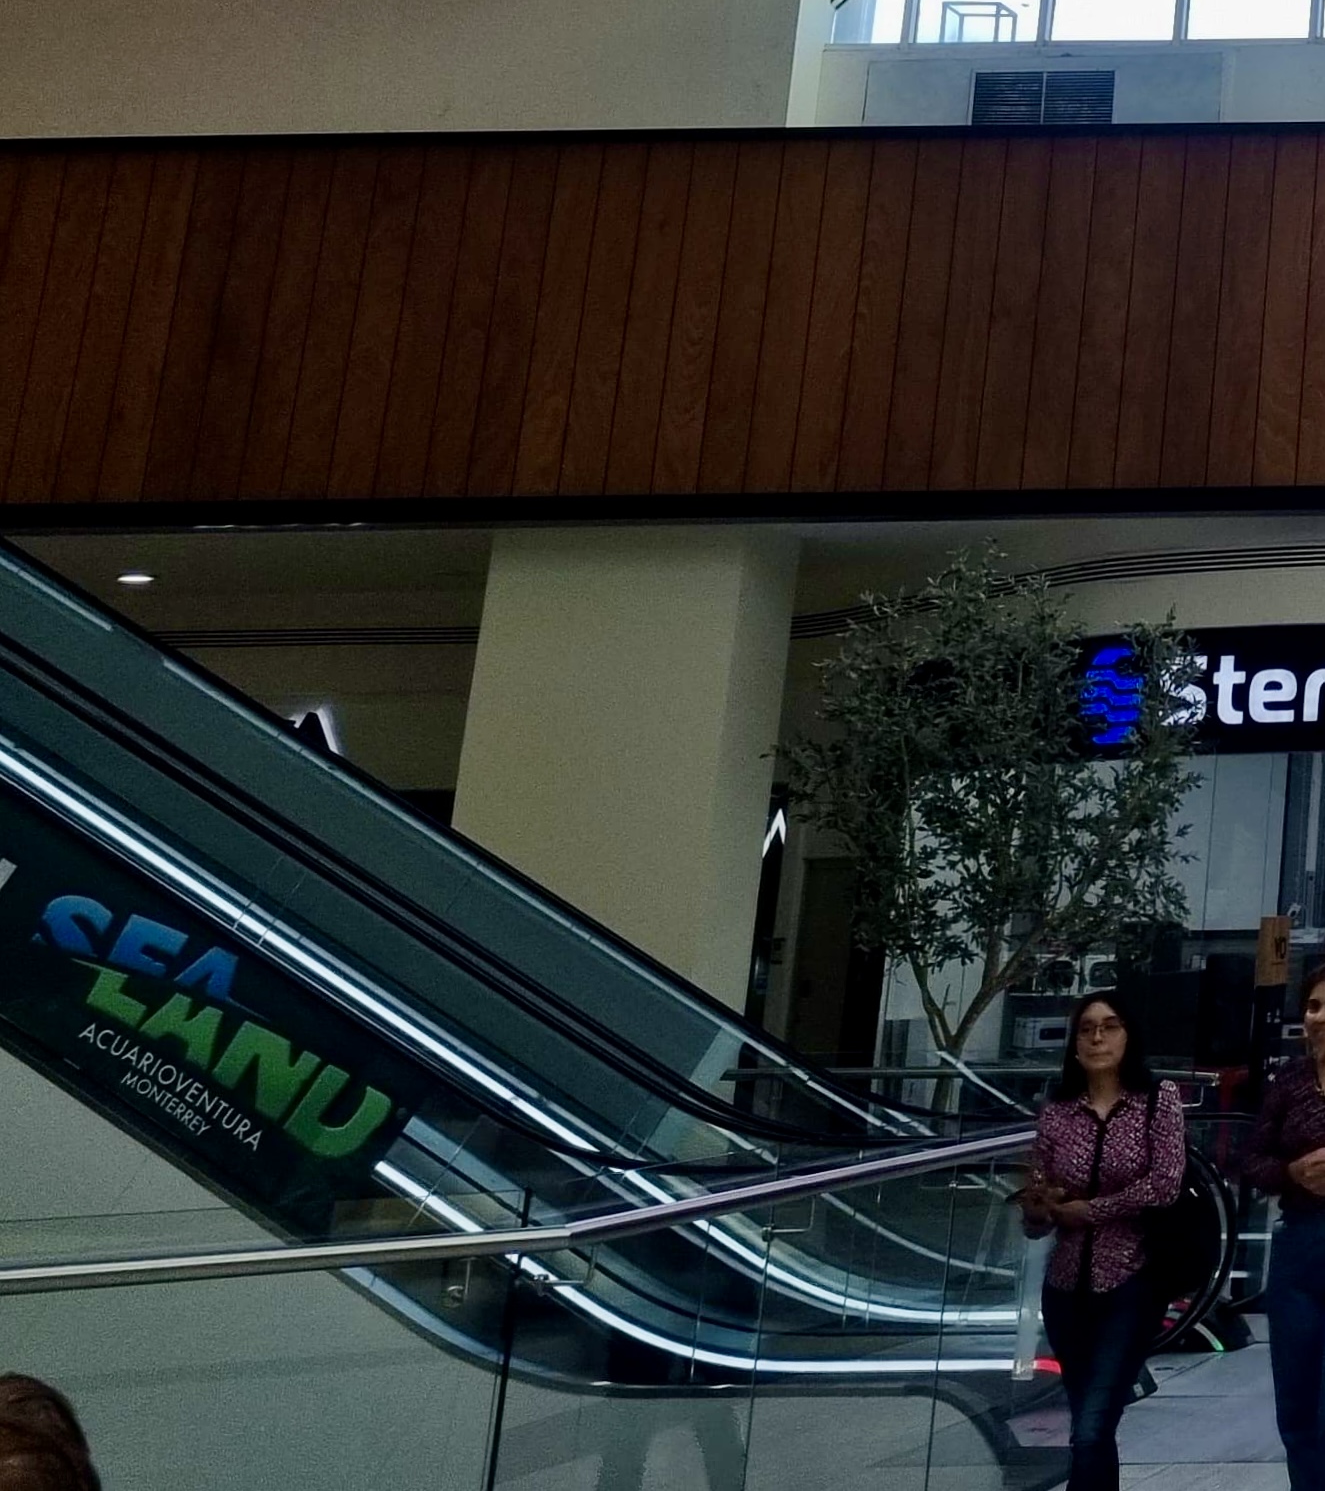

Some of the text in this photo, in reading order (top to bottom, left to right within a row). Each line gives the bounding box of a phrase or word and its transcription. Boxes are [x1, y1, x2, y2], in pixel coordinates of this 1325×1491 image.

[33, 895, 239, 1002] SEA
[78, 1022, 264, 1152] ACUARIOVENTURA
[120, 1071, 212, 1137] MONTERREY
